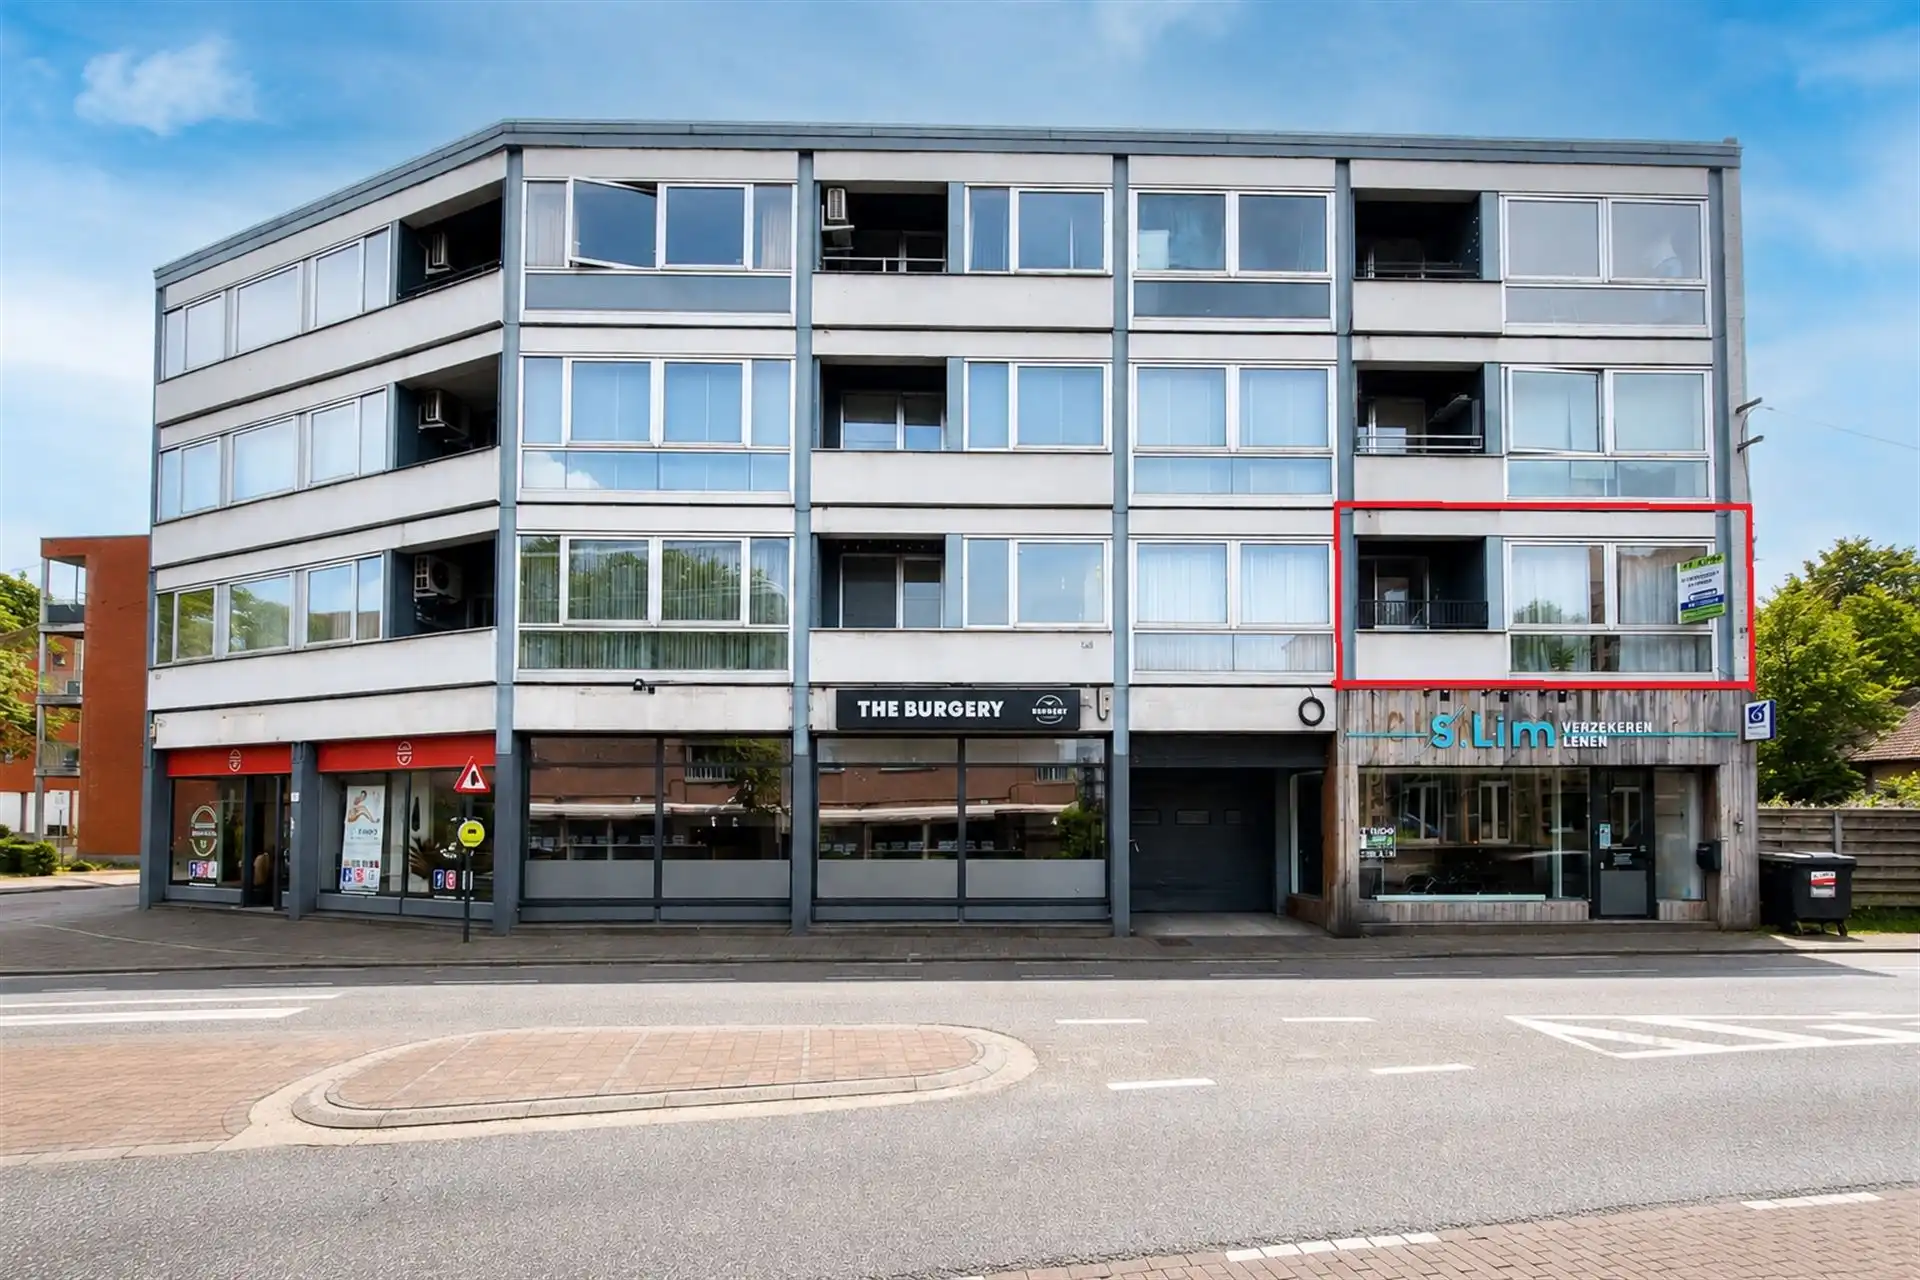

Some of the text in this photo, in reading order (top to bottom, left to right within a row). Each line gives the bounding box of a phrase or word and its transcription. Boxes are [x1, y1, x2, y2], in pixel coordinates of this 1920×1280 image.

[857, 700, 1004, 718] THE BURGERY
[1561, 721, 1653, 734] VERZEKEREN
[1563, 736, 1608, 748] LENEN
